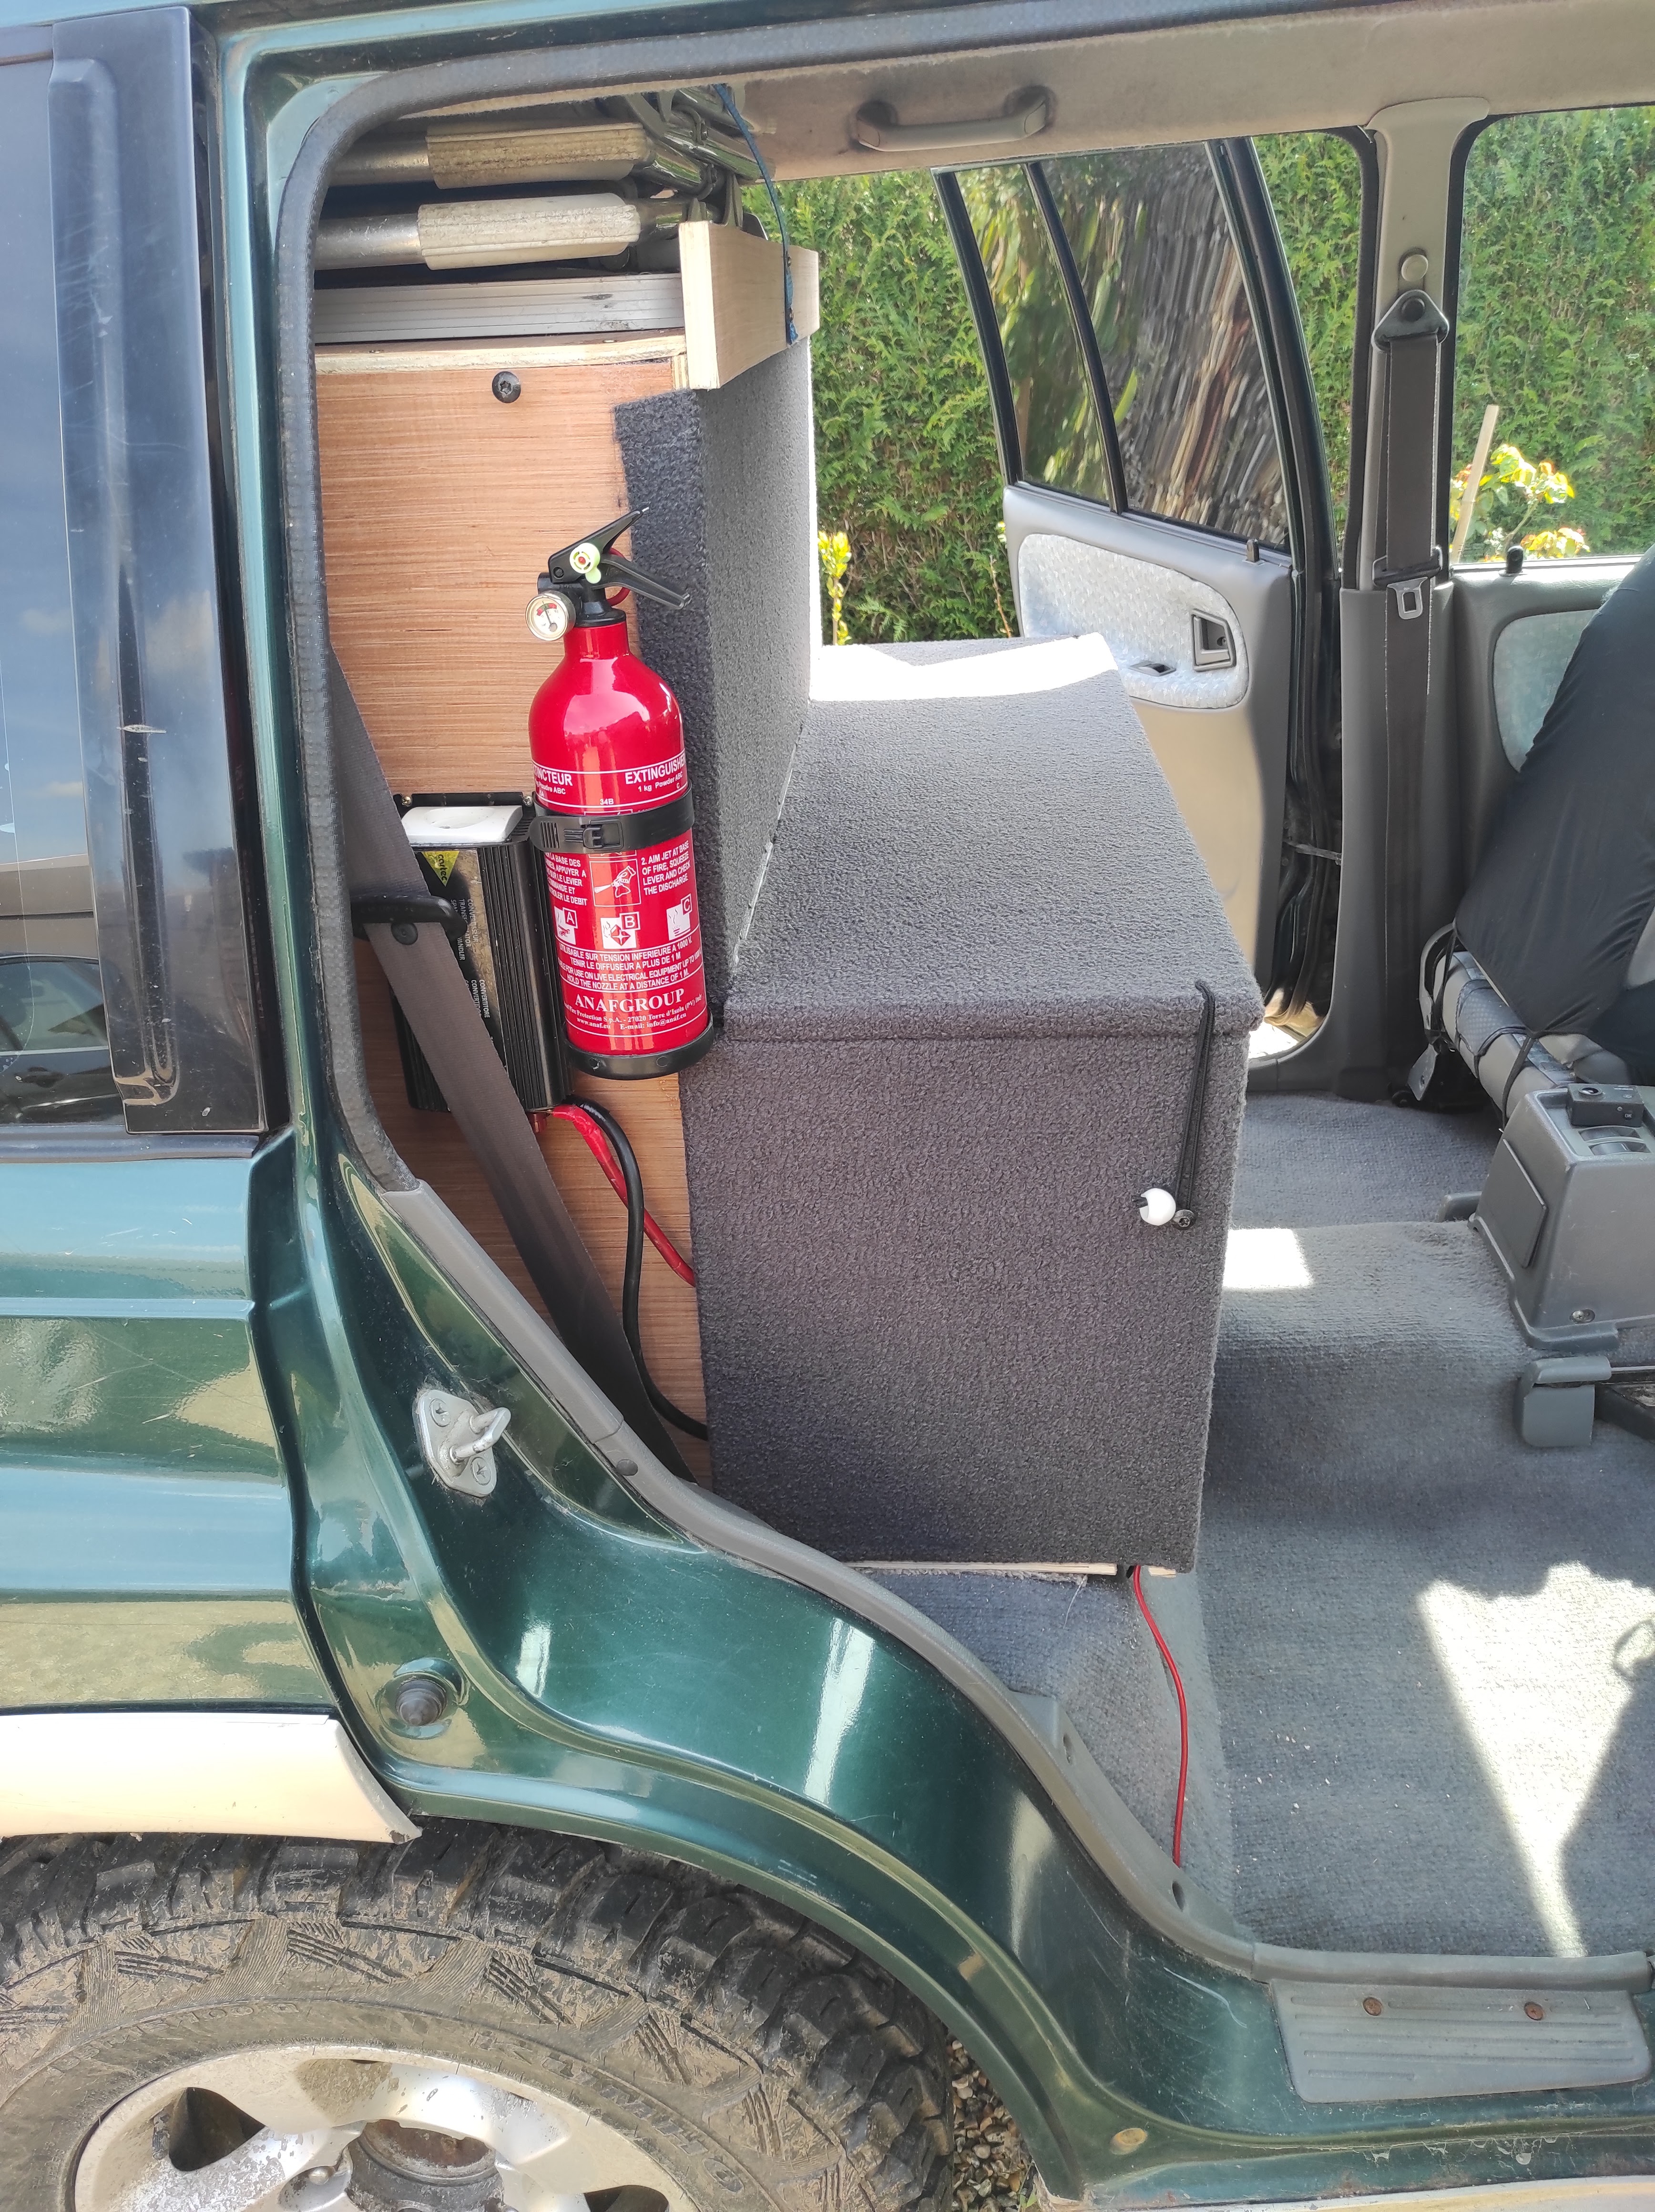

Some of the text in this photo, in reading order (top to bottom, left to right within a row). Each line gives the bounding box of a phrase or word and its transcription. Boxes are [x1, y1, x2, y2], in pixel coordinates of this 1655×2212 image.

[553, 786, 566, 795] ABC
[655, 778, 675, 789] Powder
[675, 771, 684, 781] ABC
[555, 854, 569, 866] BASE
[569, 858, 581, 868] DES
[641, 840, 689, 866] 2. AIM JET AT BASE
[642, 850, 689, 876] OF FIRE, SQUEEZE
[438, 854, 448, 881] cartec
[556, 864, 580, 877] APPUYER
[582, 870, 587, 878] A
[643, 860, 691, 886] LEVER AND CHECK
[557, 873, 563, 882] LE
[563, 875, 583, 887] LEVIER
[568, 886, 575, 895] ET
[644, 873, 689, 896] THE DISCHARGE.
[563, 893, 571, 903] LE
[570, 896, 588, 906] DEBIT
[684, 898, 690, 911] C
[467, 899, 479, 942] CONVERTISSEUR
[566, 911, 575, 924] A
[624, 915, 635, 928] B
[559, 942, 585, 959] UTILISABLE
[585, 952, 599, 962] SUR
[599, 953, 630, 962] TENSION
[632, 946, 671, 961] INFERIEURE
[672, 944, 677, 952] A
[677, 938, 688, 950] 1000
[565, 964, 574, 975] FOR
[574, 968, 584, 978] USE
[584, 972, 594, 980] ON
[593, 973, 608, 982] LIVE
[608, 971, 649, 982] ELECTRICAL
[649, 962, 682, 979] EQUIPMENT
[682, 958, 689, 968] UP
[688, 954, 695, 964] TO
[570, 956, 586, 968] TENIR
[586, 961, 595, 970] LE
[595, 959, 634, 971] DIFFUSEUR
[635, 961, 641, 970] A
[642, 958, 660, 969] PLUS
[661, 955, 671, 965] DE
[675, 951, 681, 960] M
[567, 968, 689, 991] HOLD THE NOZZLE AT A DISTANCE OF 1 M.
[479, 979, 490, 1018] CONVERTITORE
[574, 988, 684, 1013] ANAFGROUP
[576, 1009, 603, 1022] Protection
[603, 1016, 623, 1024] S.p.A.
[627, 1015, 647, 1023] 27020
[648, 1013, 665, 1021] Torre
[666, 1006, 684, 1017] d'Isola
[685, 999, 695, 1011] (PV)
[576, 1017, 611, 1030] www.anaf.eu
[646, 1013, 687, 1027] info@anaf.eu
